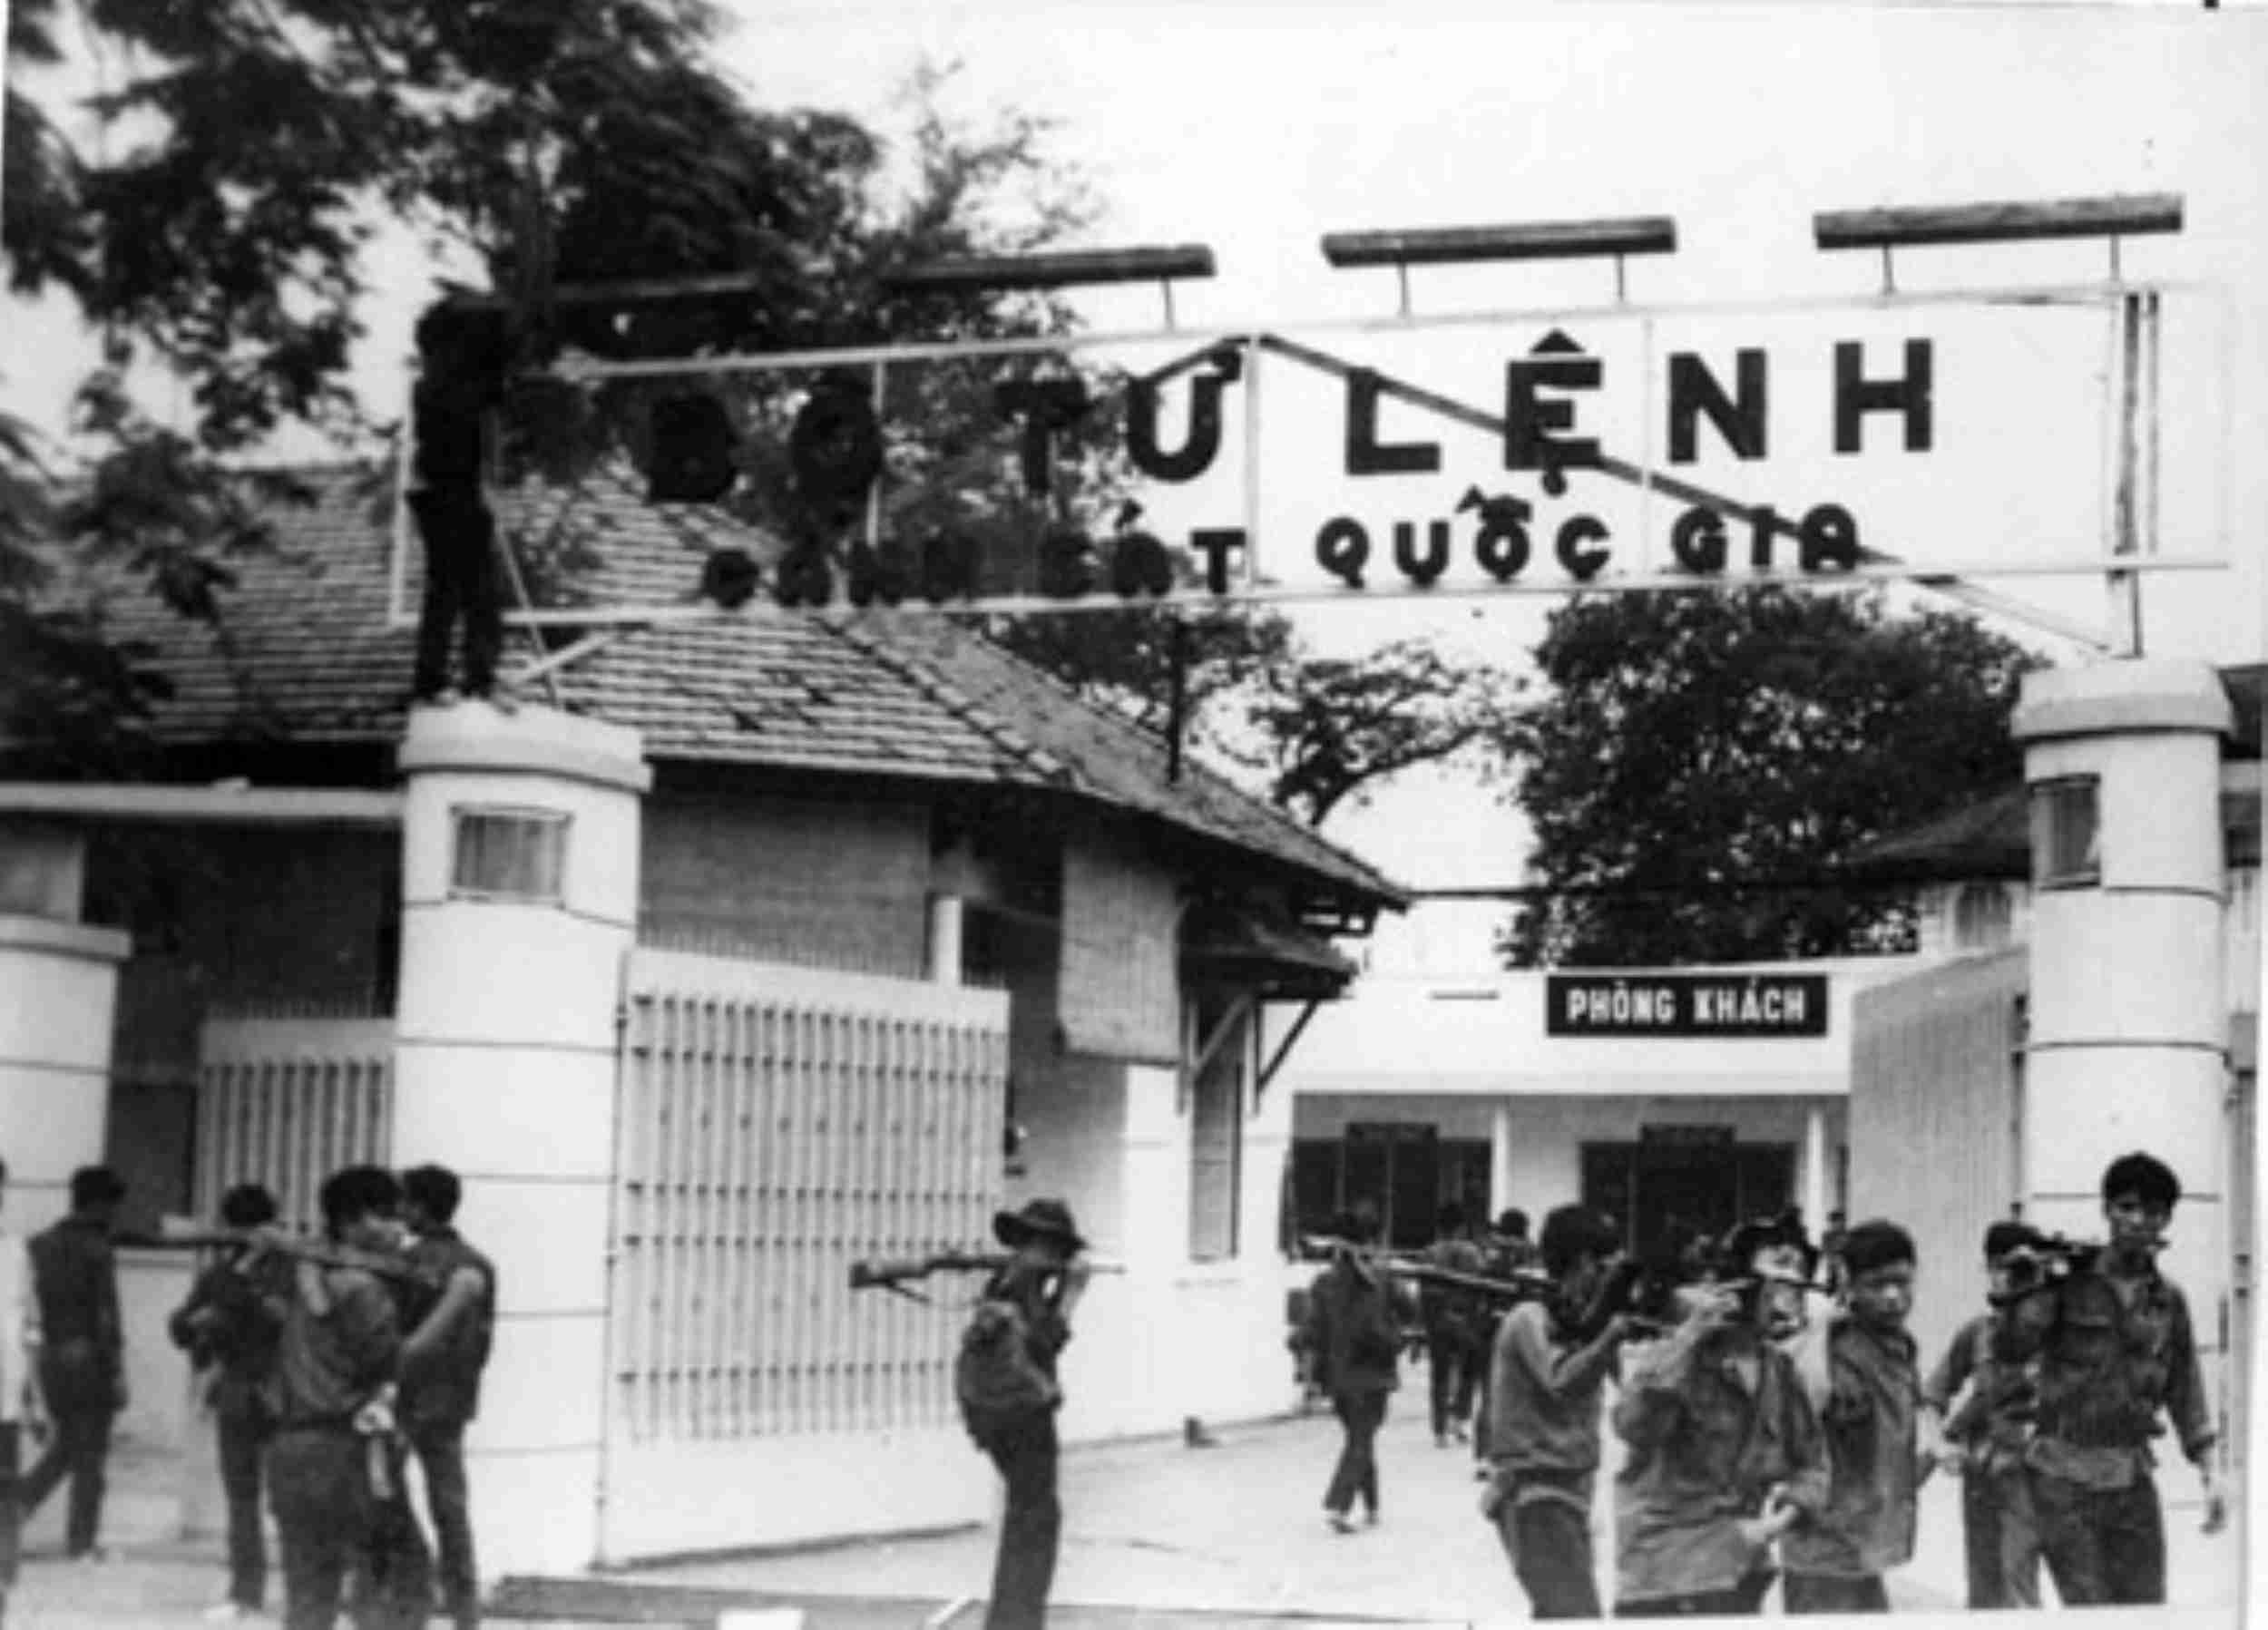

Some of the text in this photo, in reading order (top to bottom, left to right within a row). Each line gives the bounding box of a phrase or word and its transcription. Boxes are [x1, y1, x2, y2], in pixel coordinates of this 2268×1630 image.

[994, 350, 1241, 493] TƯ
[1344, 328, 1933, 497] LỆNH
[1315, 484, 1612, 590] QUỐC
[1669, 503, 1858, 574] GIA
[1566, 975, 1805, 1024] PHÒNG KHÁCH
